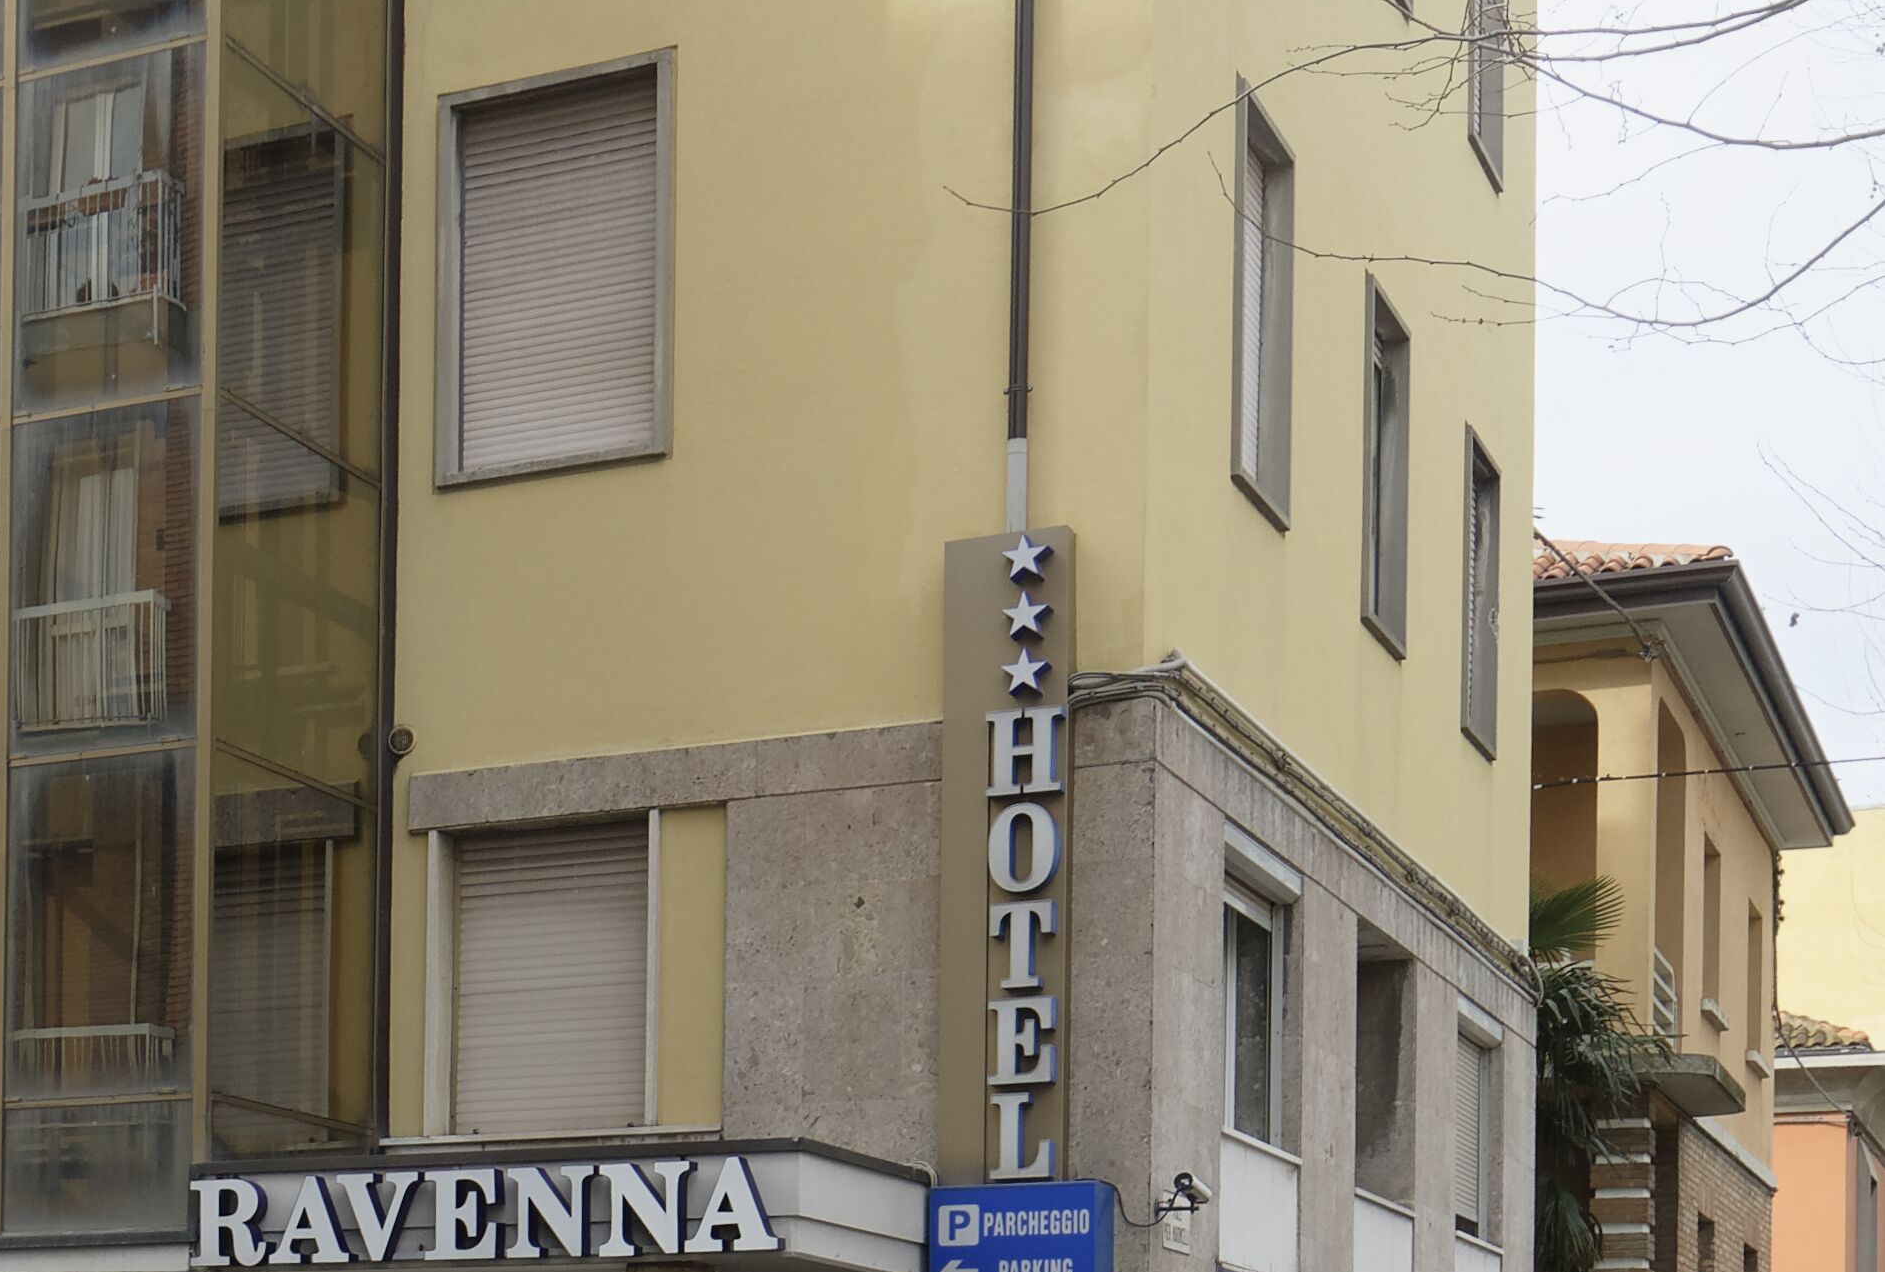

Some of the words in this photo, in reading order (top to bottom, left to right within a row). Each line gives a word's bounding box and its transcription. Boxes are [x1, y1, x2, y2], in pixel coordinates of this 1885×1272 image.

[985, 703, 1066, 1182] HOTEL
[190, 1157, 785, 1267] RAVENNA
[948, 1209, 971, 1241] P
[982, 1208, 1091, 1238] PARCHEGGIO
